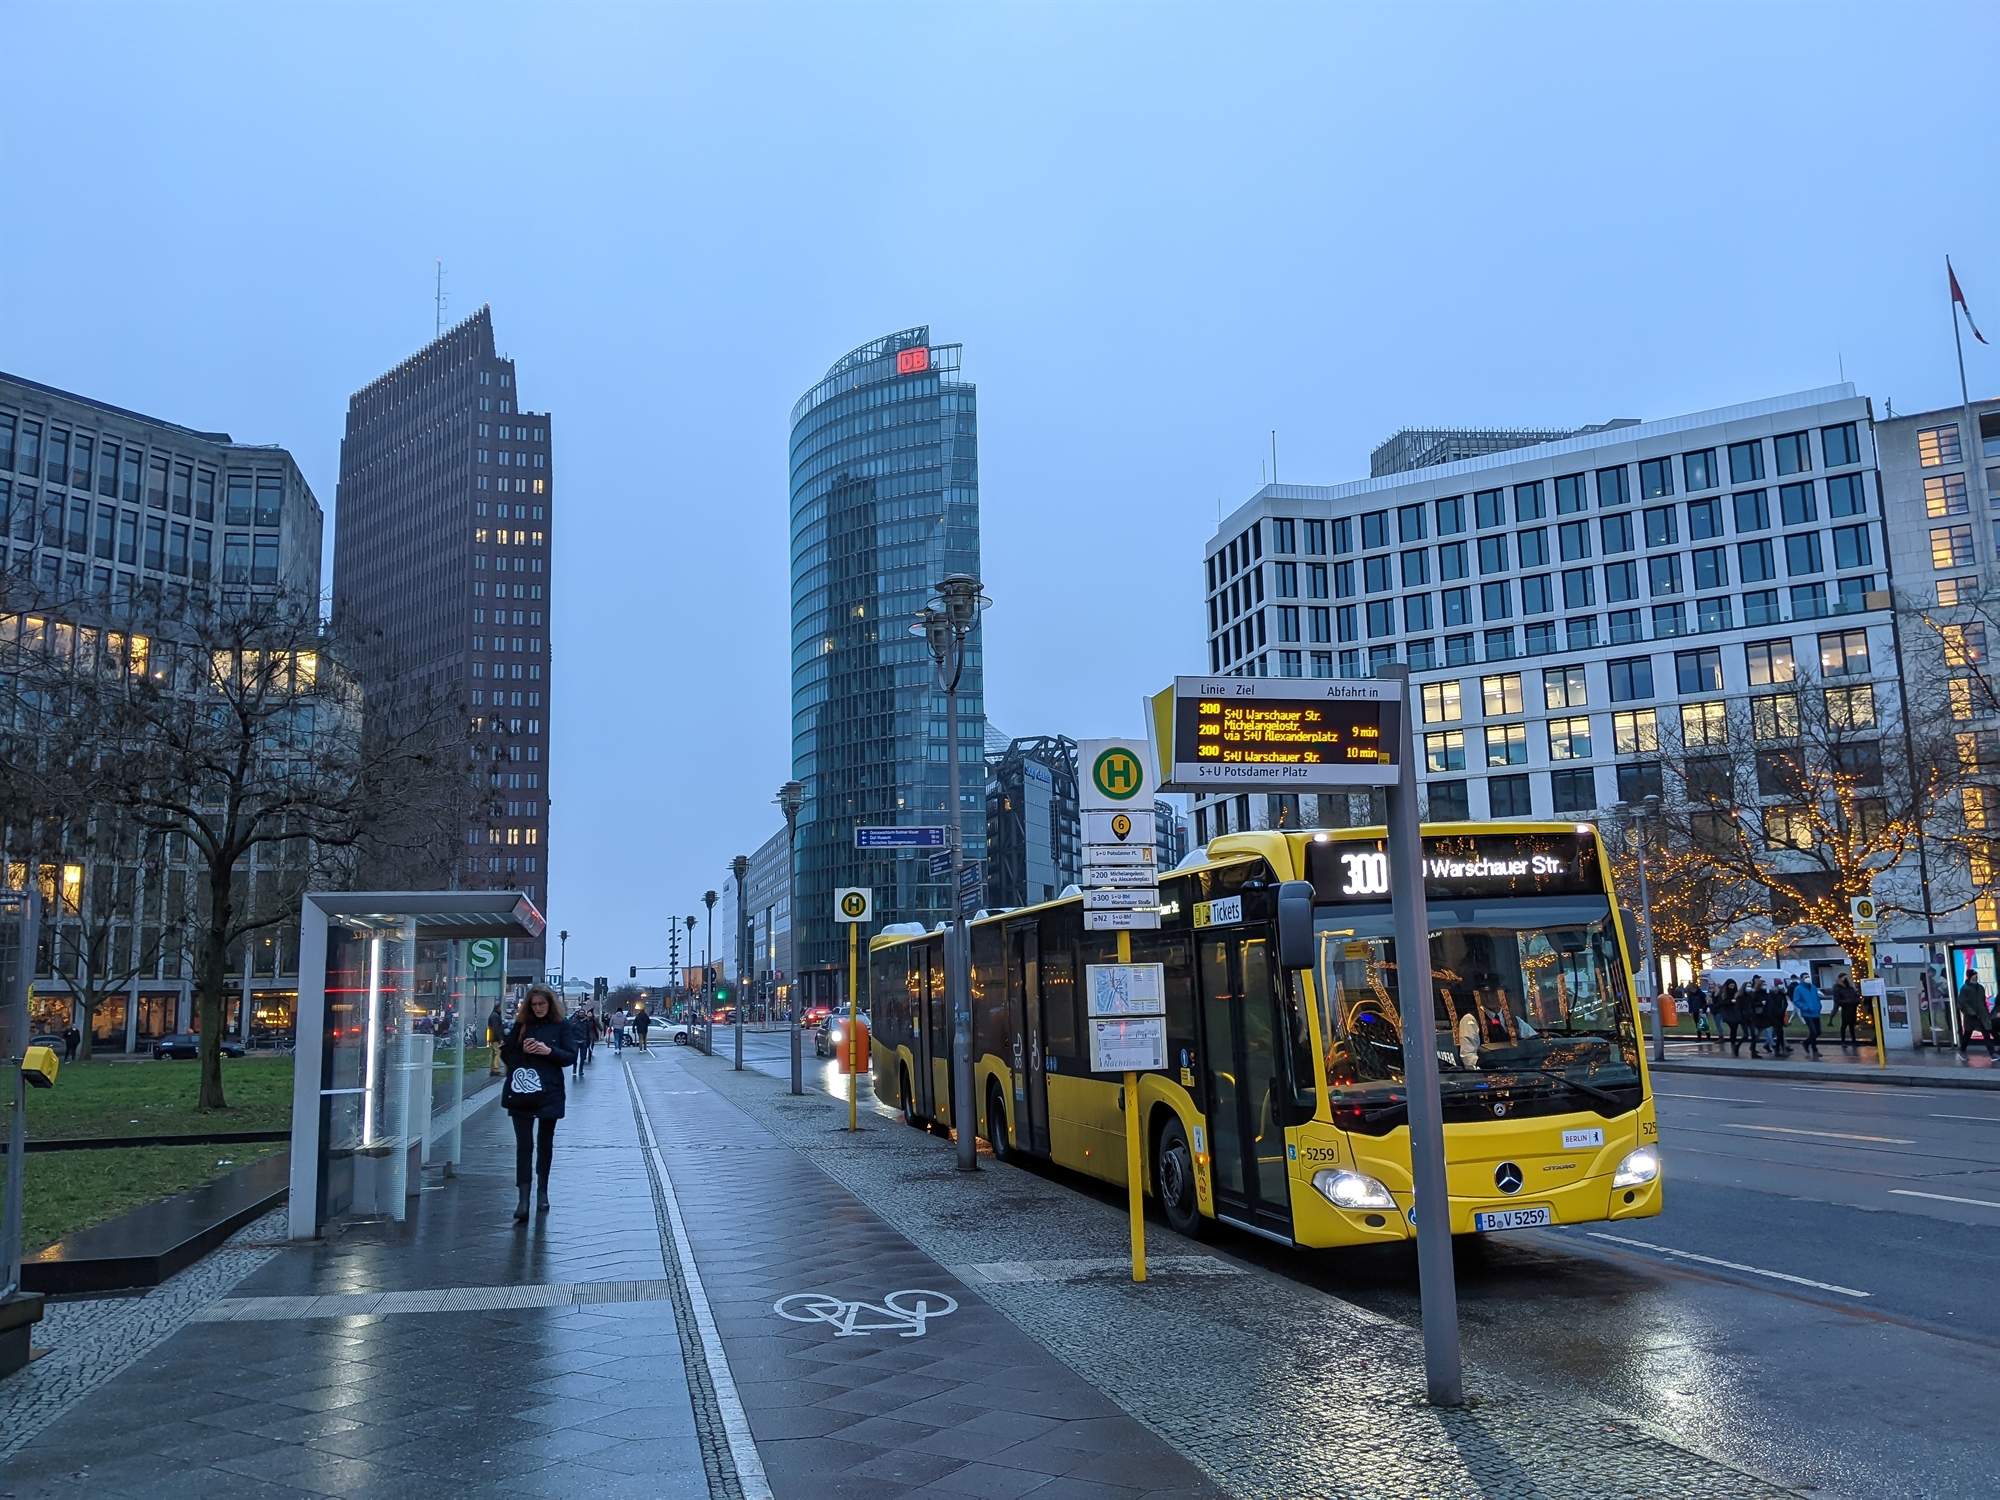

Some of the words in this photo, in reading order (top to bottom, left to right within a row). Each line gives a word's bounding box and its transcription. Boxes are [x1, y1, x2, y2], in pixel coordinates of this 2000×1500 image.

[901, 352, 924, 371] DB
[1201, 684, 1225, 695] Linie
[1236, 684, 1255, 695] Ziel
[1327, 686, 1366, 697] Abfahrt
[1369, 687, 1378, 697] in
[1199, 703, 1220, 714] 300
[1224, 709, 1243, 720] S+U
[1245, 709, 1302, 721] Warschauer
[1304, 710, 1321, 721] Str.
[1198, 724, 1220, 735] 200
[1224, 720, 1300, 731] Michelangelostr.
[1224, 730, 1241, 741] via
[1243, 731, 1262, 741] S+U
[1264, 731, 1338, 743] Alexanderplatz
[1352, 726, 1359, 737] 9
[1360, 726, 1378, 737] min
[1198, 745, 1220, 756] 300
[1346, 747, 1358, 758] 10
[1360, 747, 1378, 758] min
[1223, 751, 1242, 762] S+U
[1244, 751, 1301, 762] Warschauer
[1304, 752, 1320, 763] Str.
[1106, 760, 1131, 788] H
[1199, 766, 1221, 777] S+U
[1224, 766, 1280, 777] Potsdamer
[1282, 766, 1308, 777] Platz
[1118, 819, 1125, 830] 6
[1430, 857, 1529, 878] Warschauer
[1532, 856, 1564, 875] Str.
[1340, 853, 1388, 895] 300
[848, 897, 860, 911] H
[1862, 904, 1869, 915] H
[1212, 900, 1240, 923] Tickets
[471, 941, 495, 968] S
[551, 975, 559, 986] U
[1103, 1059, 1142, 1068] Nachtlinie
[1565, 1134, 1588, 1143] BERLIN
[1306, 1147, 1335, 1161] 5259
[1487, 1214, 1496, 1228] B
[1503, 1212, 1512, 1227] V
[1514, 1209, 1545, 1226] 5259
